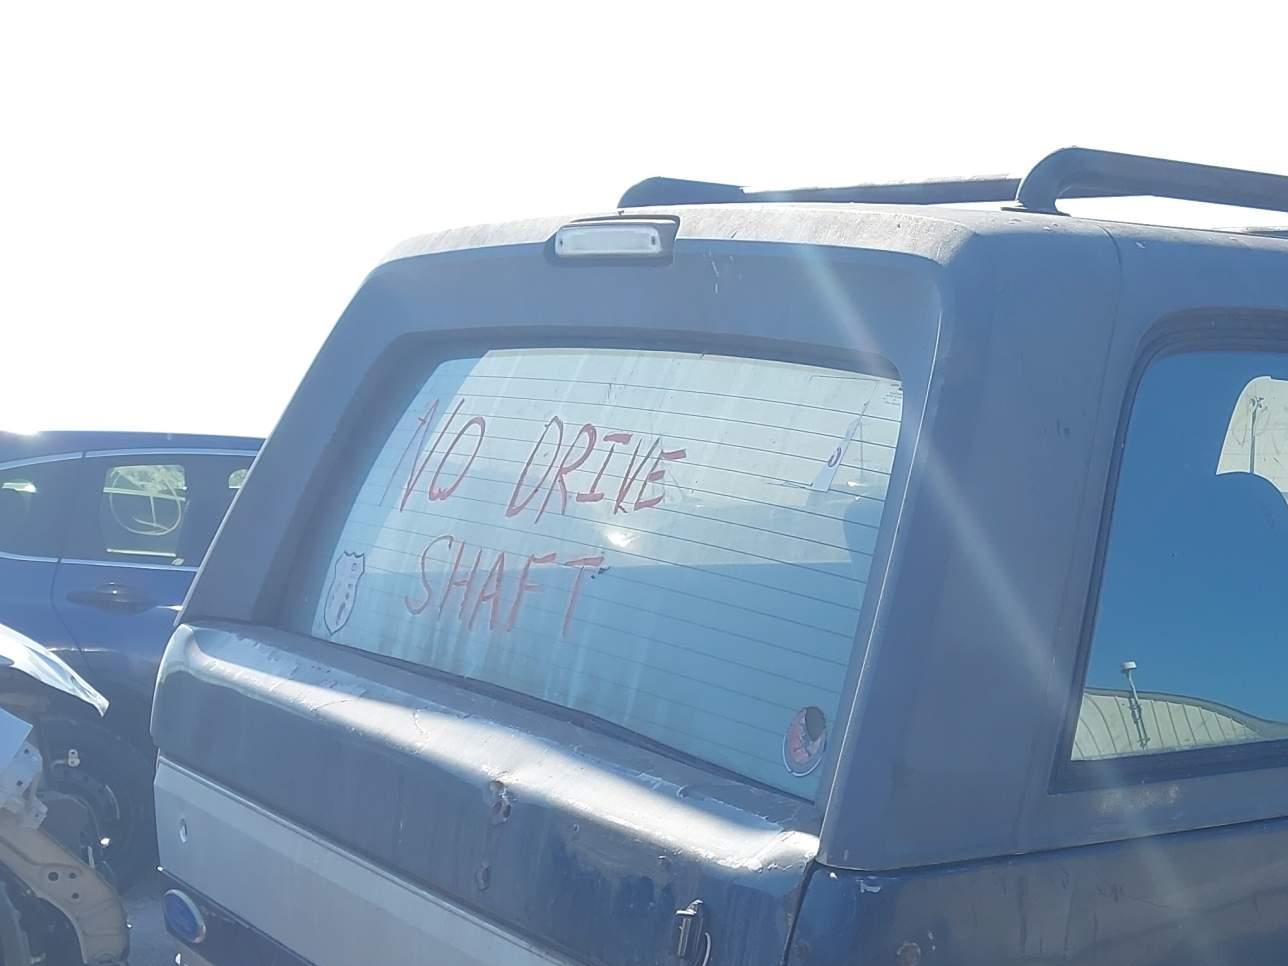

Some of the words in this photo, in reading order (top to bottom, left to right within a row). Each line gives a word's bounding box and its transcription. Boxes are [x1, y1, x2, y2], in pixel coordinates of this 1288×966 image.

[379, 398, 486, 513] NO
[505, 415, 687, 524] DRIVE
[405, 535, 605, 641] SHAFT
